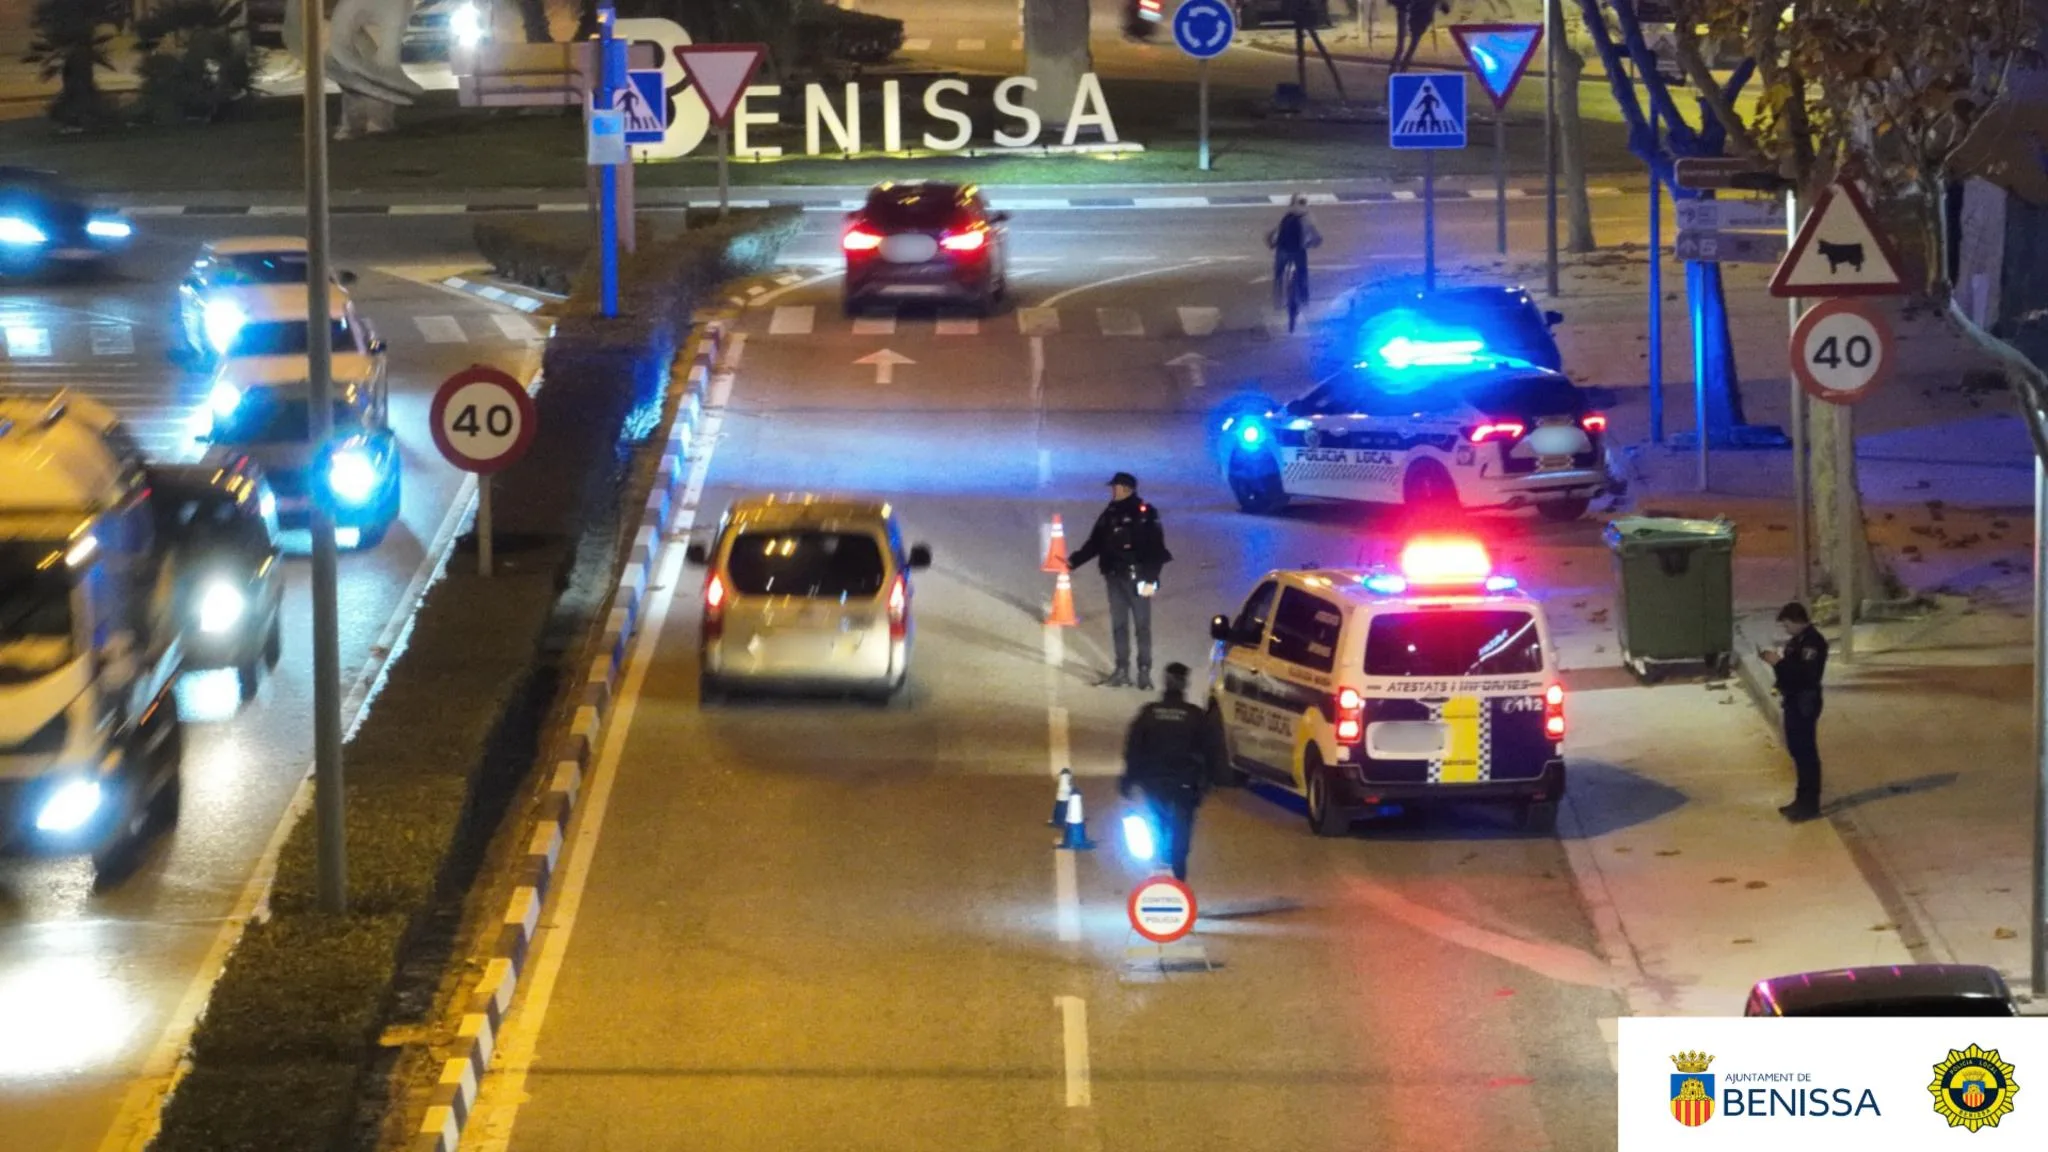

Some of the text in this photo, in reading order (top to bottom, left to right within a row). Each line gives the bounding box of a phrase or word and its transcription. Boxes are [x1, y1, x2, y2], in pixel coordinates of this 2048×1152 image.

[1813, 335, 1872, 369] 40
[452, 404, 513, 437] 40
[1356, 451, 1393, 464] LOCAL
[1387, 681, 1447, 693] ATESTATS
[1515, 698, 1543, 711] 112
